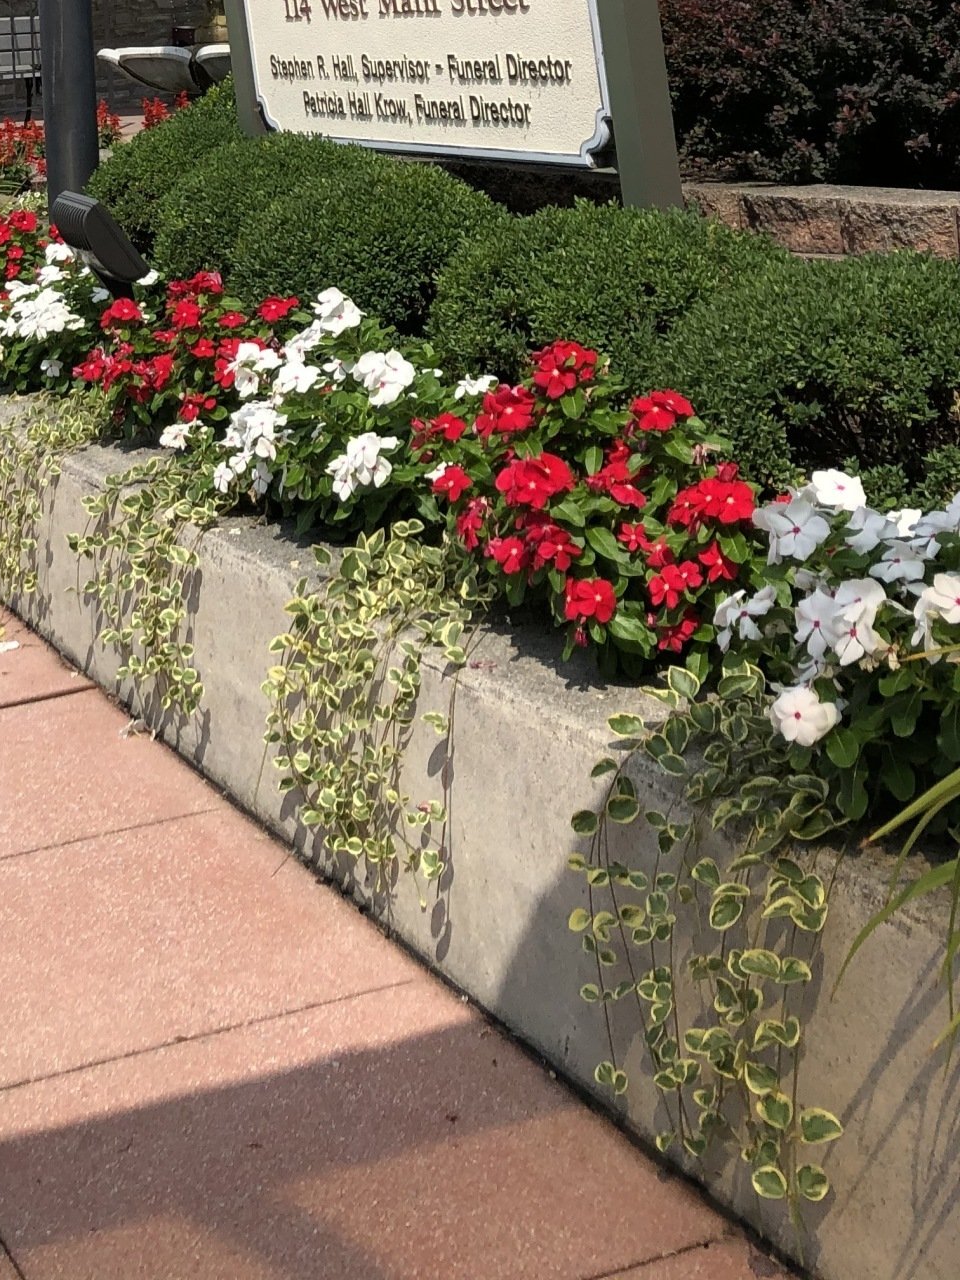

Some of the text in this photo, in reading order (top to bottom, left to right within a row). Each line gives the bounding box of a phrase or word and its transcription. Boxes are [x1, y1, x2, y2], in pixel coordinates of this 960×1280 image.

[270, 54, 314, 83] Stephen
[317, 55, 329, 79] R.
[332, 54, 358, 85] Hall,
[361, 53, 431, 84] Supervisor
[447, 53, 503, 84] Funeral
[506, 53, 572, 86] Director
[302, 90, 531, 127] Patricia Hall Krow, Funeral Director
